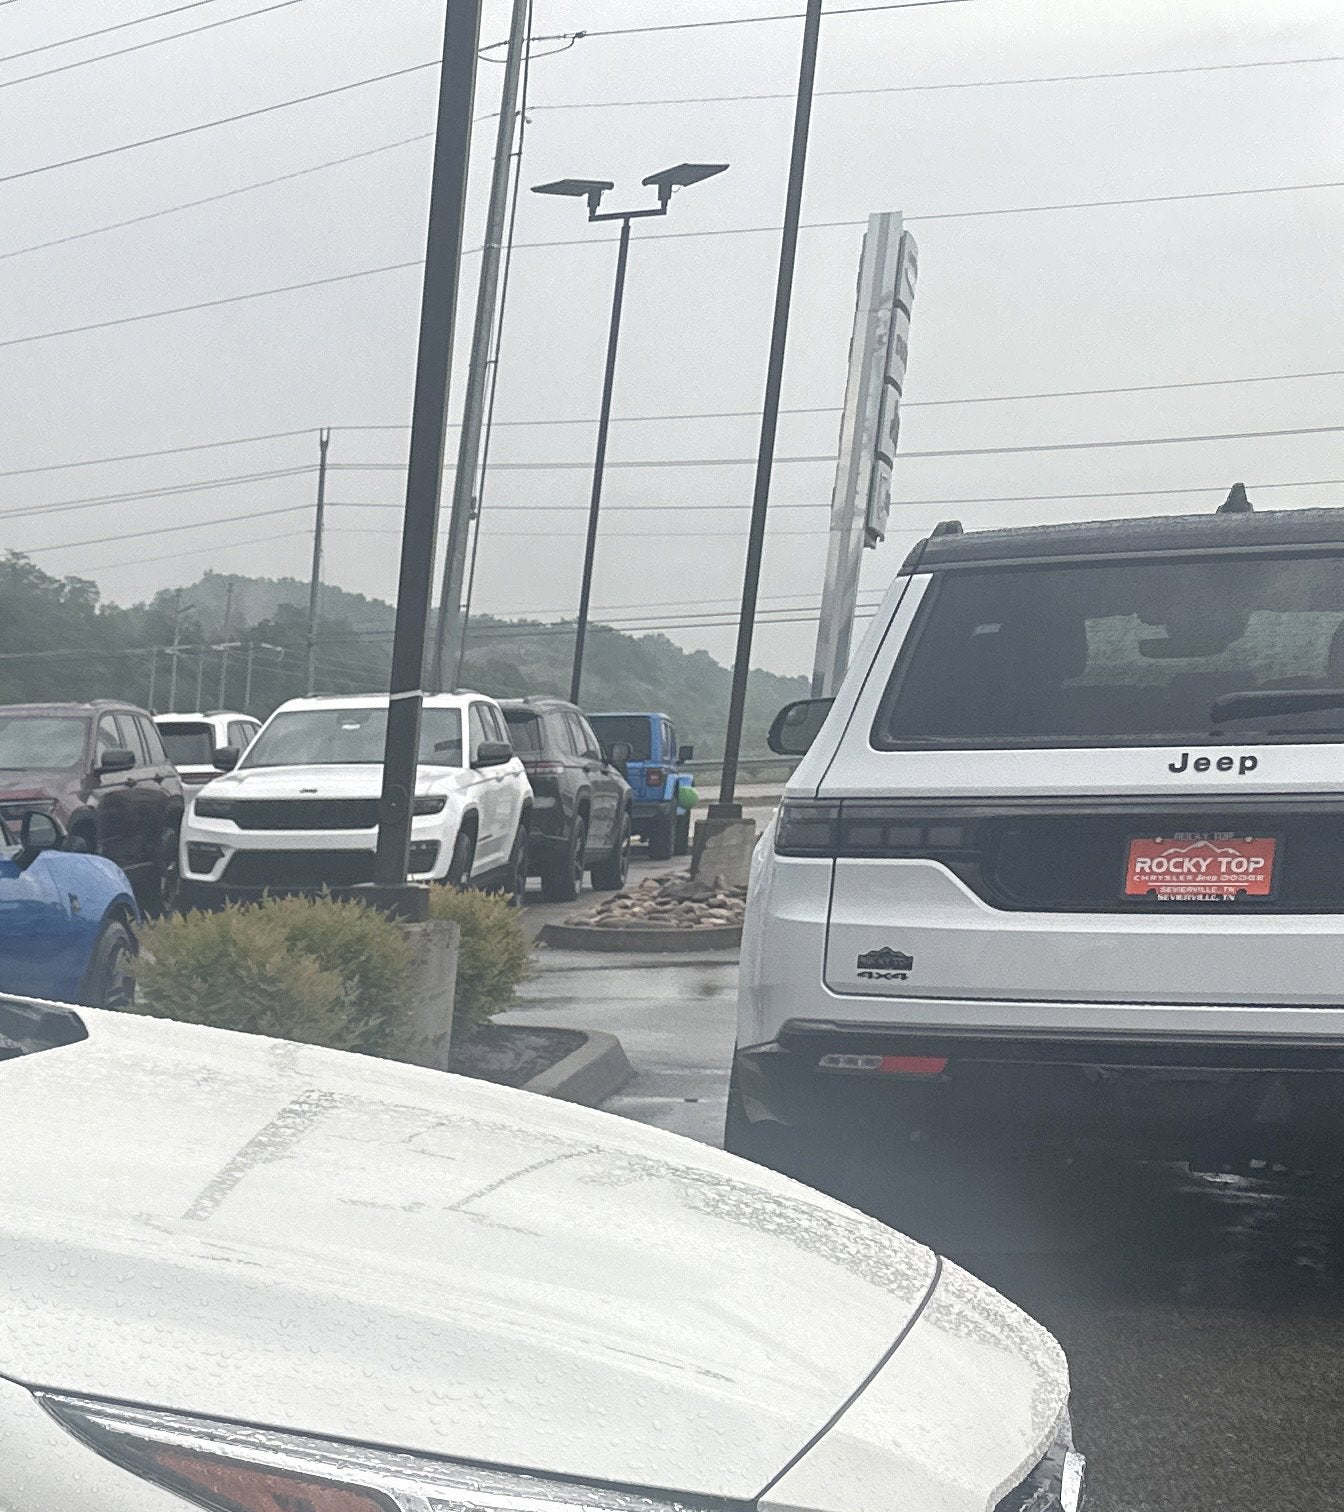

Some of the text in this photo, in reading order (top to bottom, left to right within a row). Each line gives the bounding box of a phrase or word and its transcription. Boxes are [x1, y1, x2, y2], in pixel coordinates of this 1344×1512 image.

[1168, 752, 1258, 775] Jeep
[1135, 857, 1265, 873] ROCKY TOP
[1133, 874, 1193, 882] CHRYSLER
